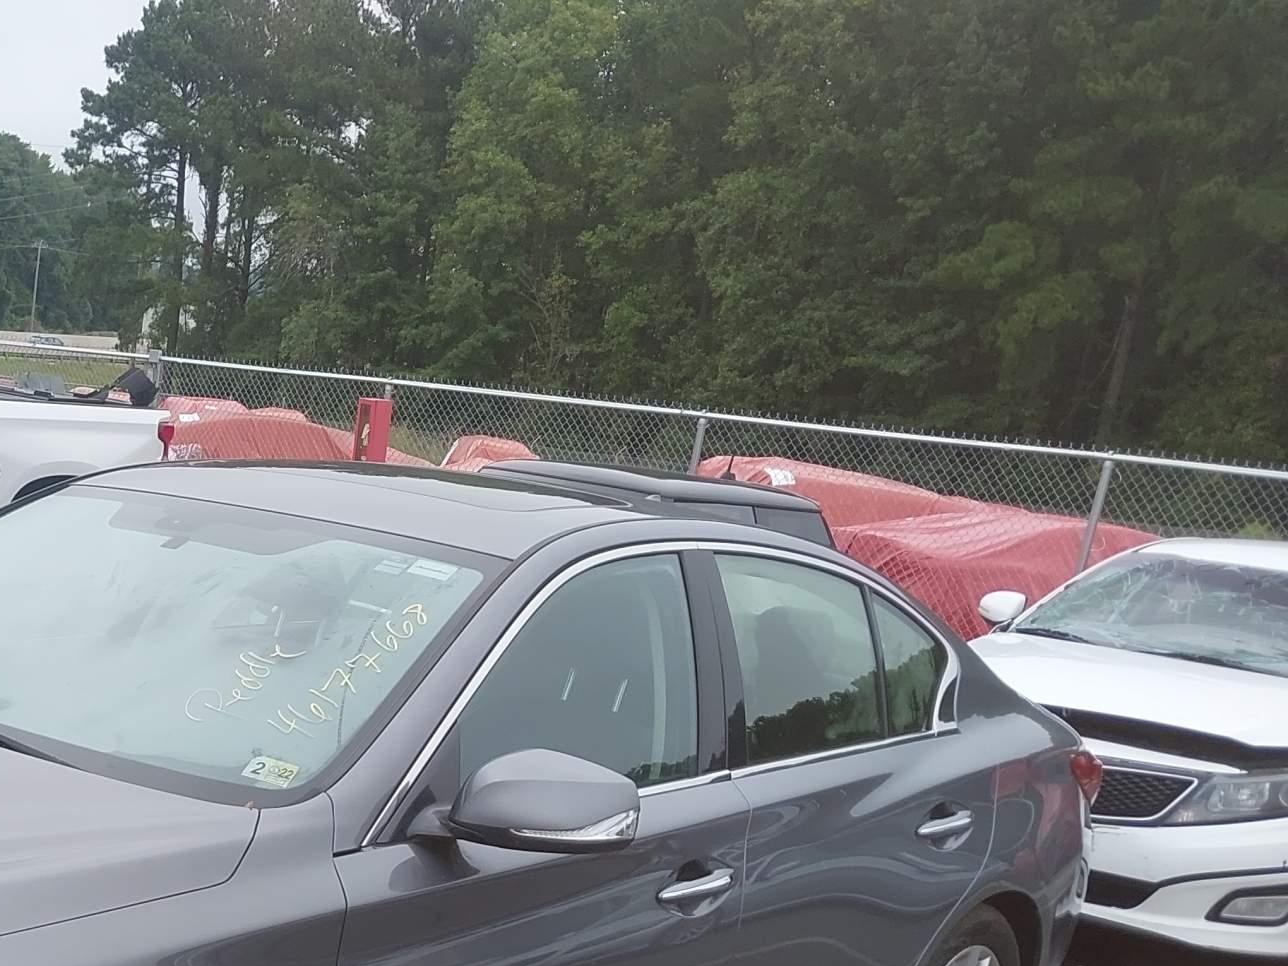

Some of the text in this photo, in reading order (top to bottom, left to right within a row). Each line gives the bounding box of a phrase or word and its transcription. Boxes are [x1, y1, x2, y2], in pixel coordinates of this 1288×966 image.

[267, 602, 428, 738] 46177668
[250, 761, 267, 775] 2
[278, 768, 295, 780] 22
